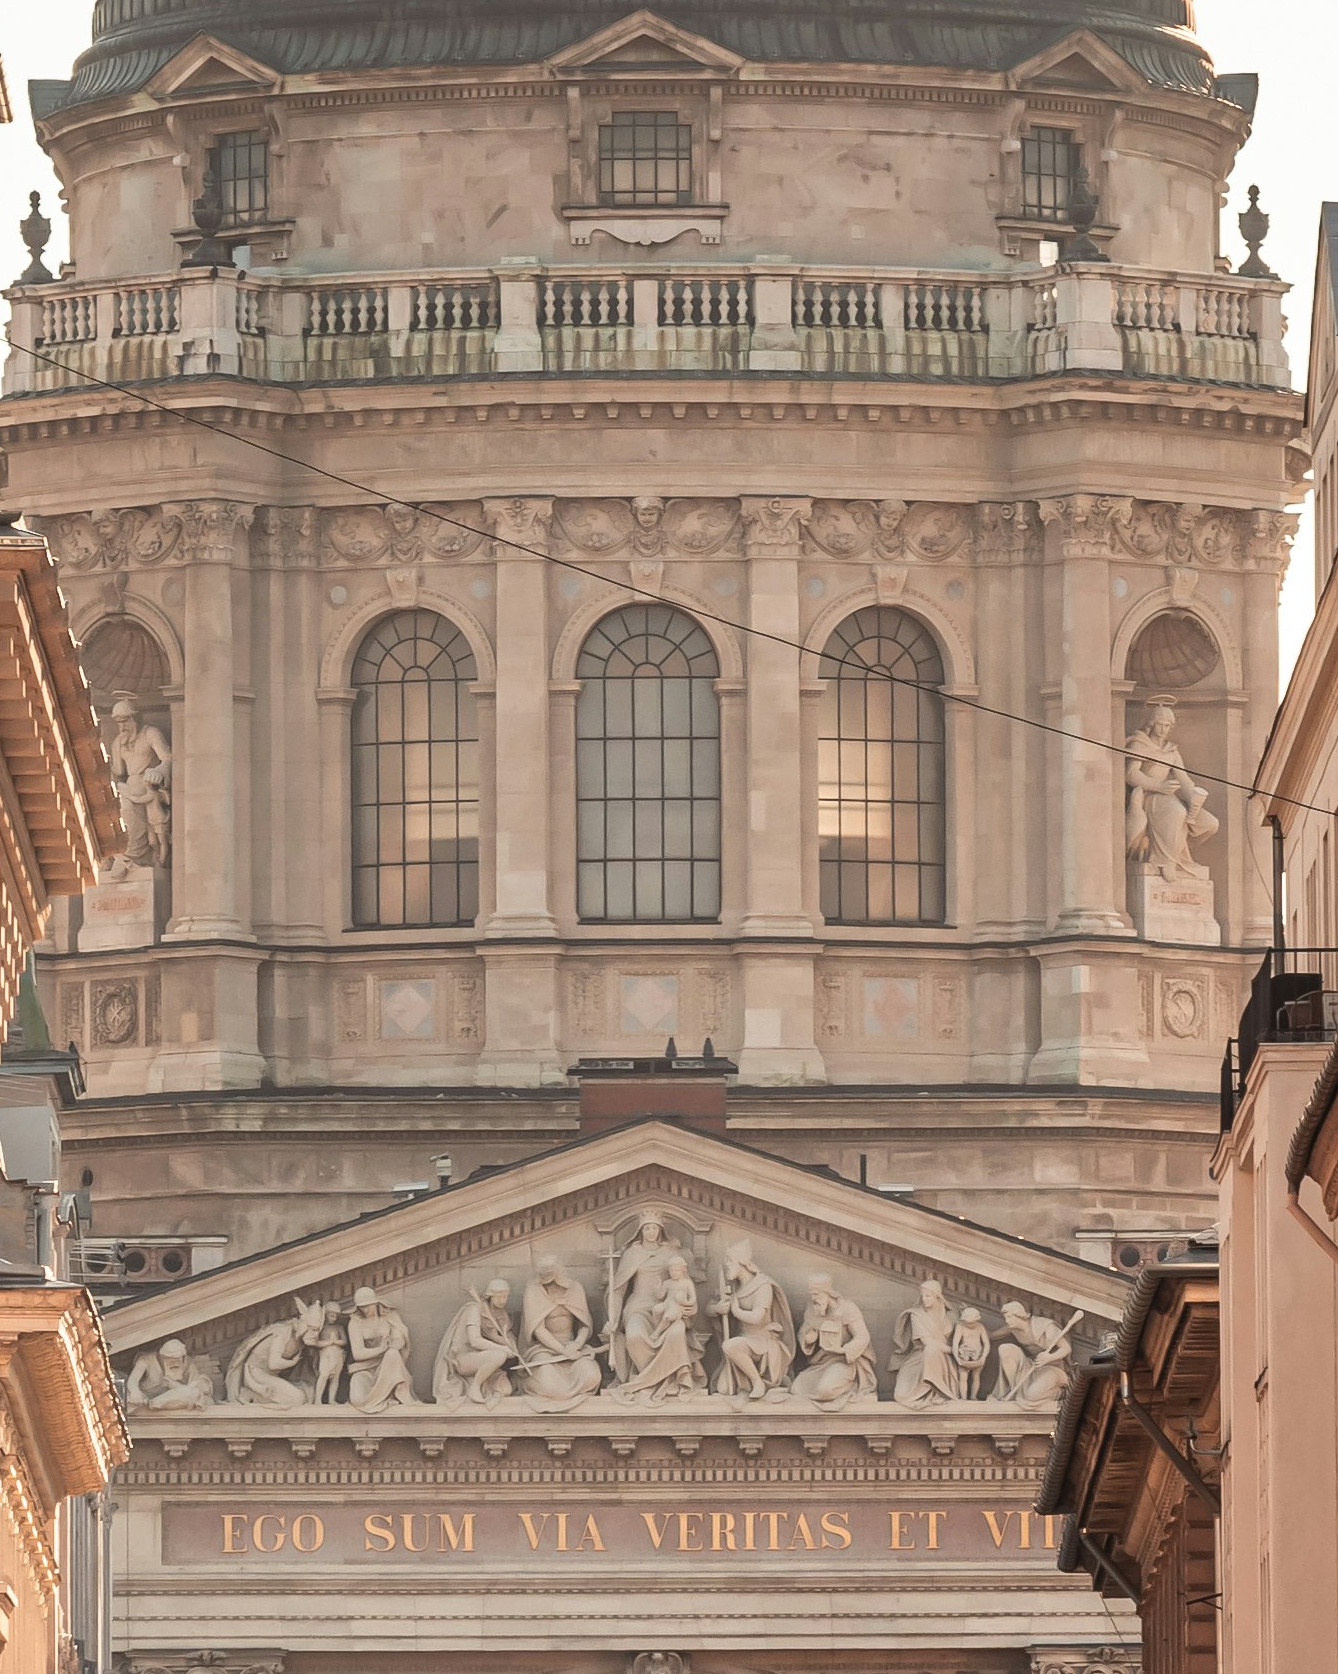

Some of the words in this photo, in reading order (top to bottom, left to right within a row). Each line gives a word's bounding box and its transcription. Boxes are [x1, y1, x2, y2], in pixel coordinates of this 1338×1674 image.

[221, 1514, 325, 1553] EGO
[364, 1513, 476, 1552] SUM
[518, 1513, 607, 1552] VIA
[640, 1511, 853, 1551] VERITAS
[888, 1510, 947, 1550] ET
